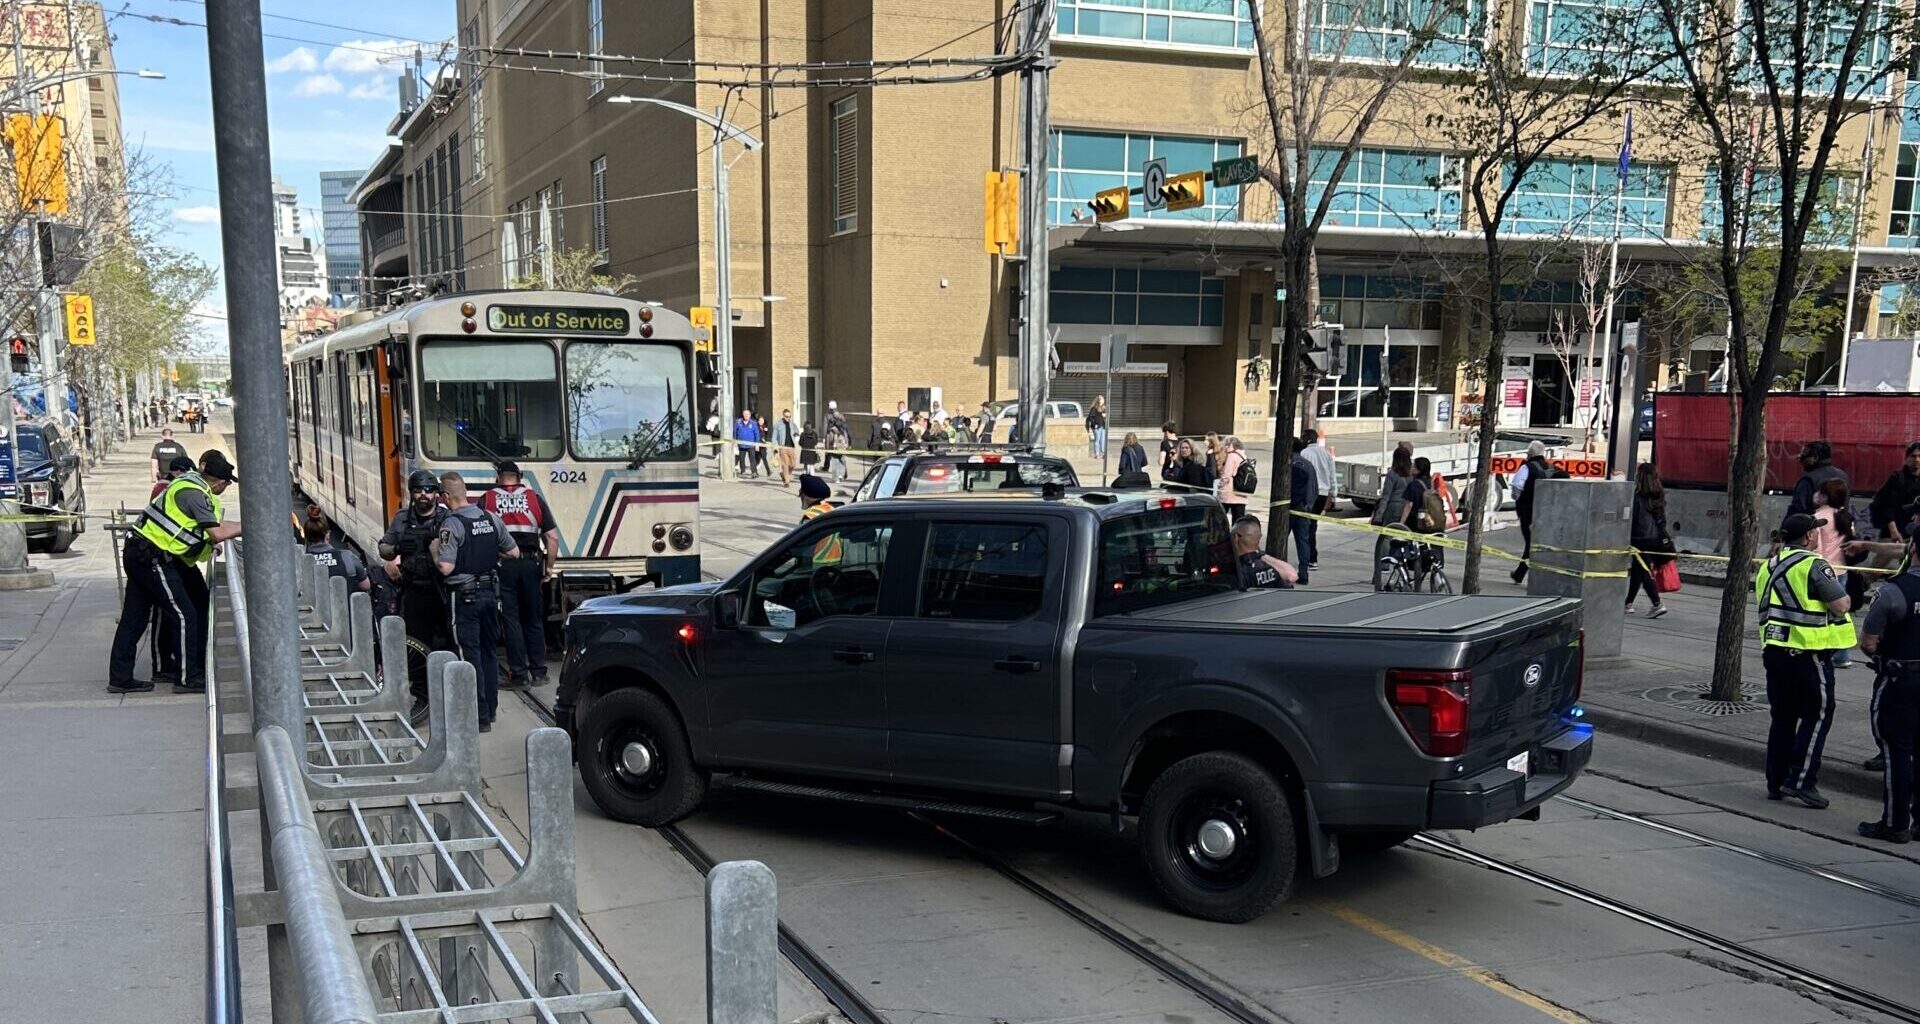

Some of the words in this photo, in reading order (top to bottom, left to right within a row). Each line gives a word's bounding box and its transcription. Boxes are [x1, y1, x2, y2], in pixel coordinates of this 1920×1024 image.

[494, 310, 526, 328] Out
[532, 312, 550, 328] of
[555, 312, 624, 330] Service
[1492, 457, 1526, 472] RO
[1552, 460, 1606, 475] CLOS
[550, 470, 587, 483] 2024
[495, 498, 529, 509] POLICE
[471, 526, 494, 536] OFFICER
[314, 553, 332, 561] EACE
